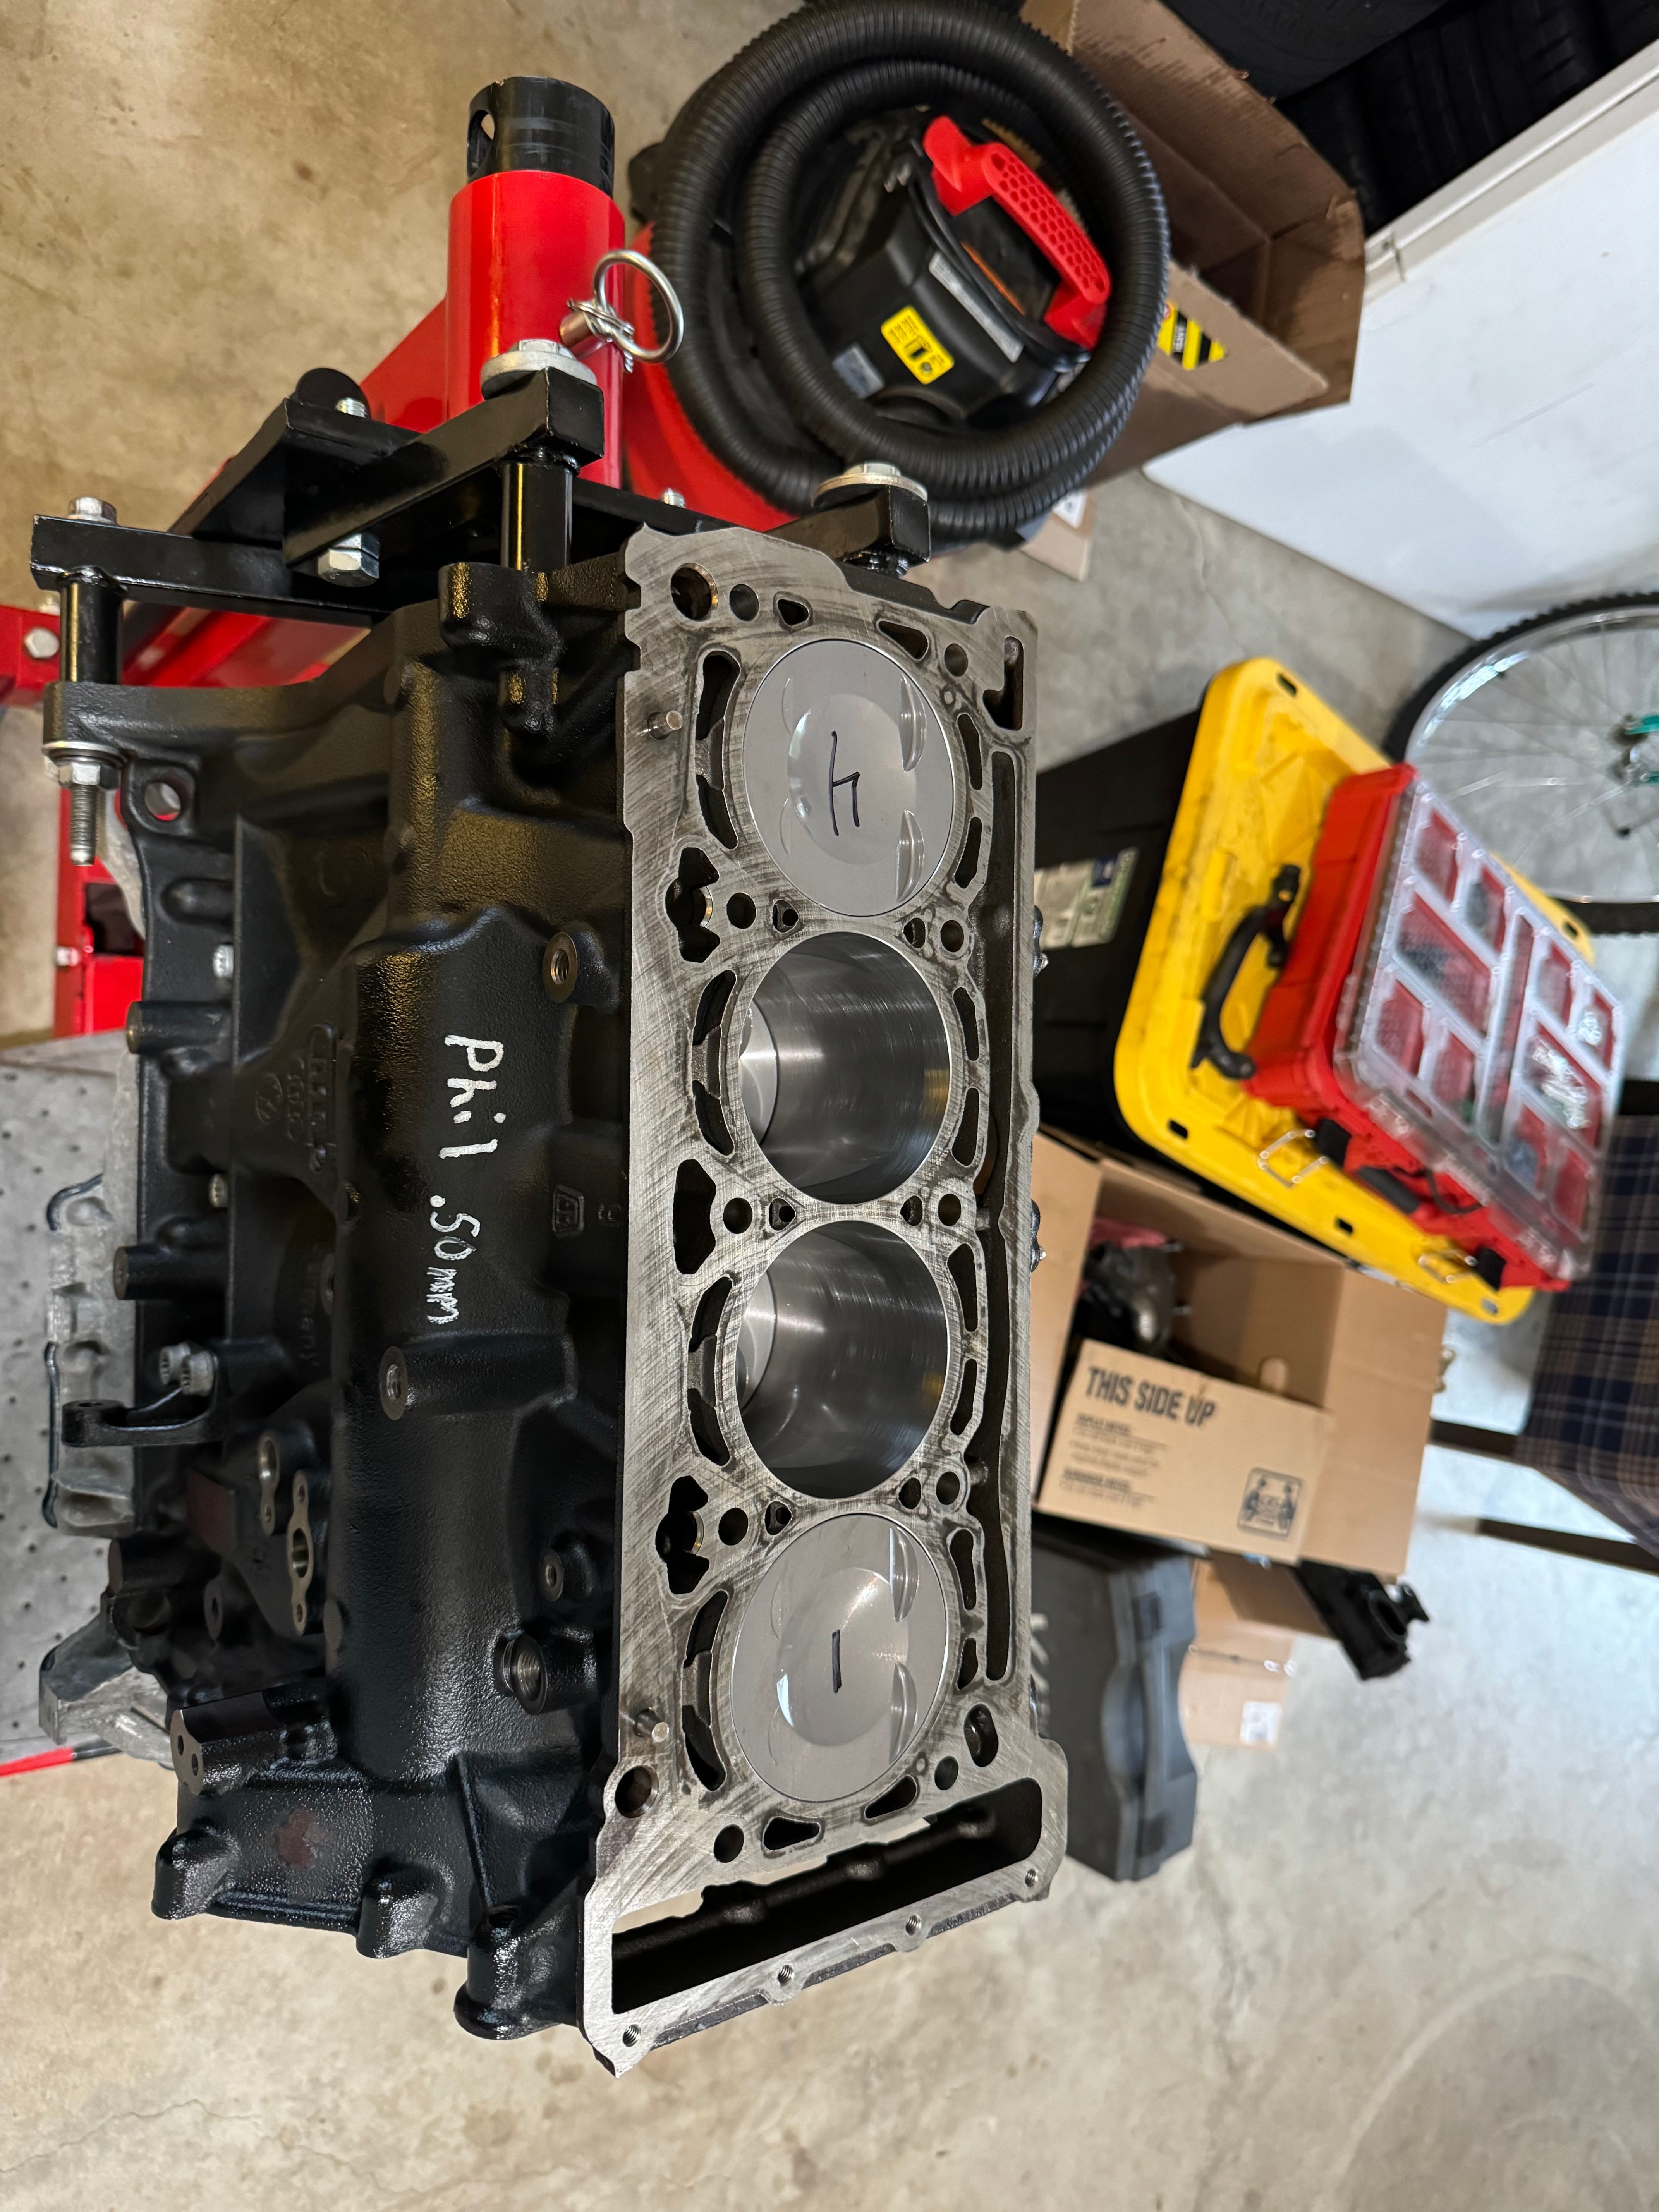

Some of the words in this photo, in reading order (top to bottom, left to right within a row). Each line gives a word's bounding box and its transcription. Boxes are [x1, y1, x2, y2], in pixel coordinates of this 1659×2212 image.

[439, 1035, 507, 1159] Phil
[1086, 1366, 1133, 1407] THIS
[1134, 1380, 1183, 1420] SIDE
[1185, 1395, 1216, 1427] UP
